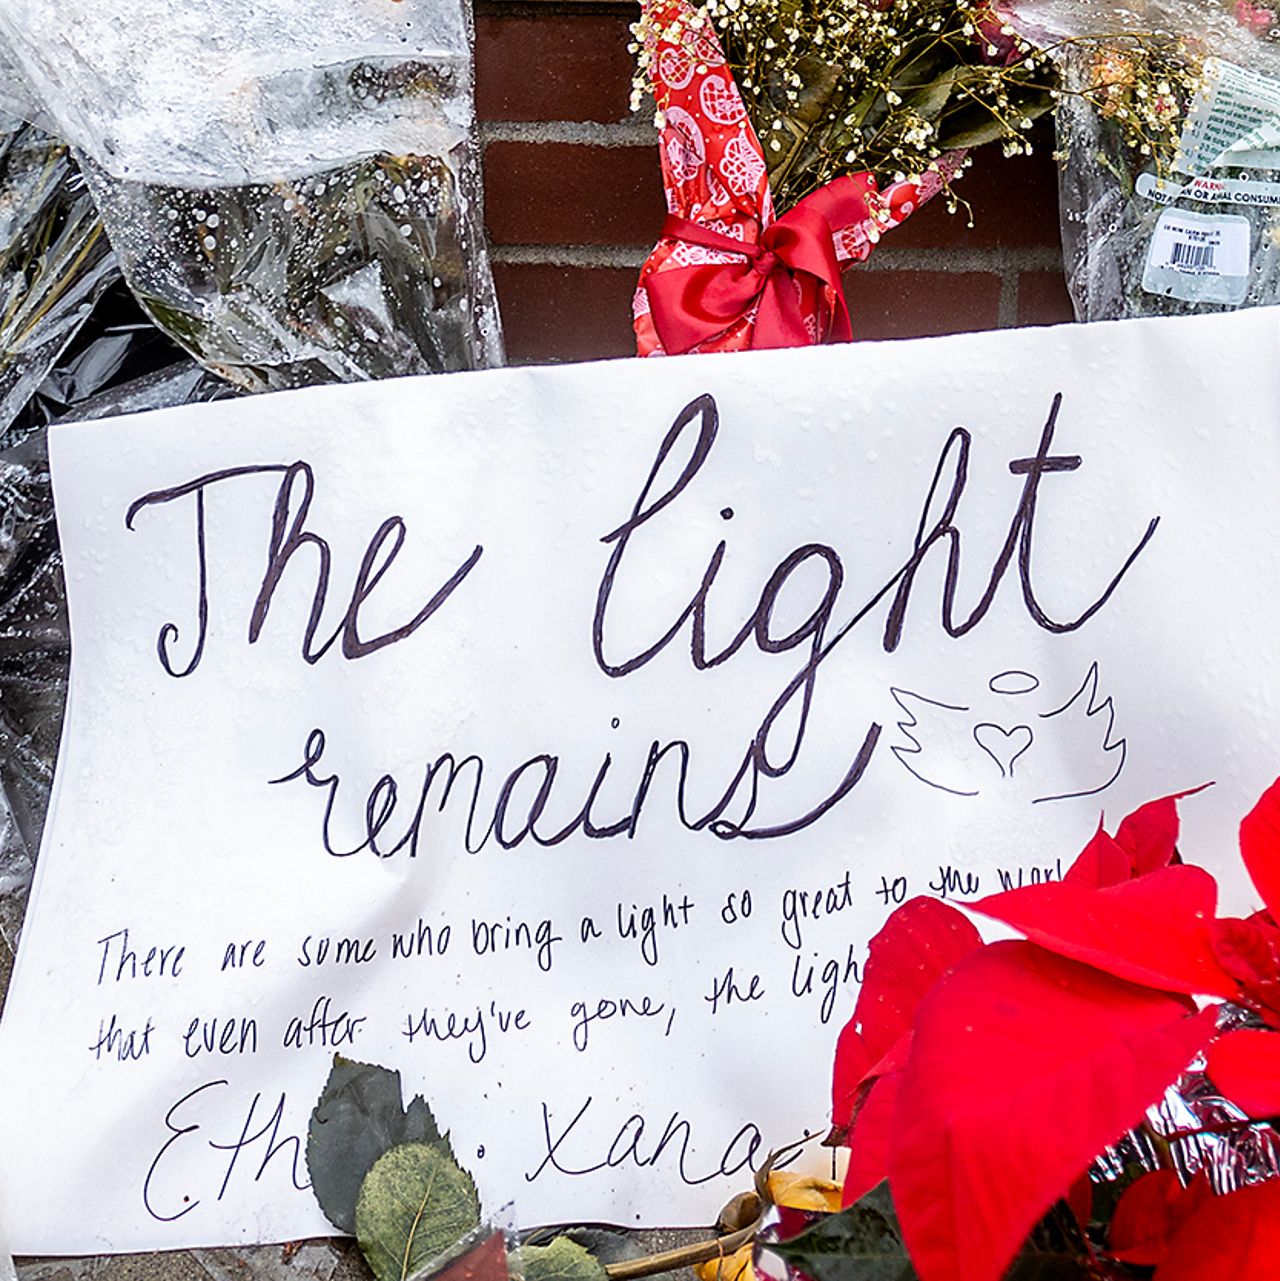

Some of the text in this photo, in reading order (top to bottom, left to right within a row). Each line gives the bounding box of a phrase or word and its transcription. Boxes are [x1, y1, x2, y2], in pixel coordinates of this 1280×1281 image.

[126, 392, 1160, 777] The light
[268, 720, 882, 858] remains
[98, 858, 1063, 984] There are some who bring a light so great to the worl
[89, 1015, 154, 1061] that
[183, 1014, 257, 1057] even
[403, 1001, 530, 1063] they've
[571, 997, 675, 1051] gone,
[705, 968, 765, 1013] the
[792, 954, 864, 1023] ligh
[144, 1080, 312, 1221] Eth
